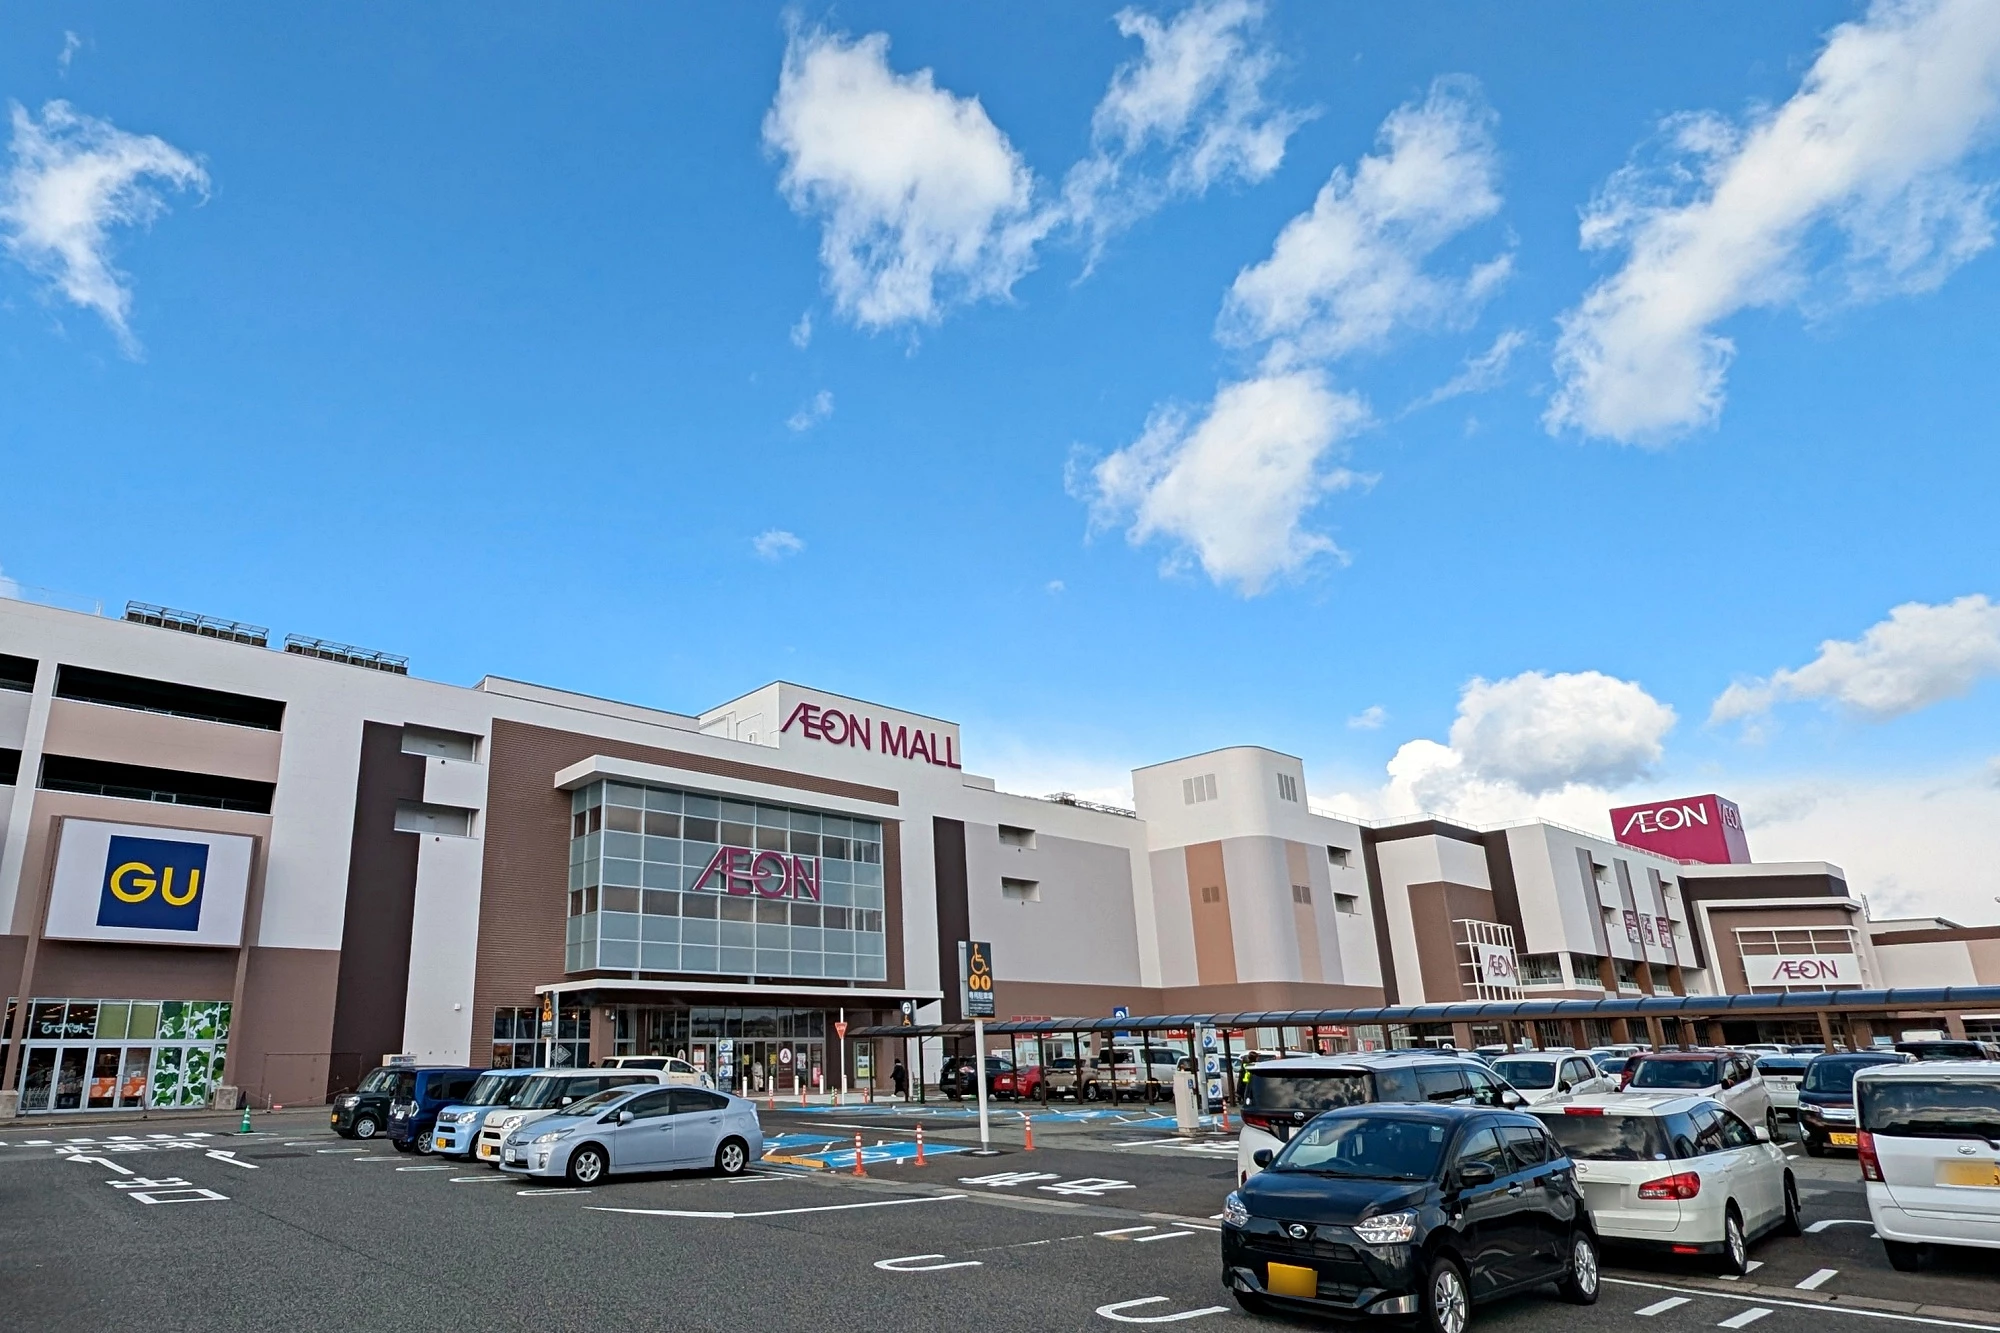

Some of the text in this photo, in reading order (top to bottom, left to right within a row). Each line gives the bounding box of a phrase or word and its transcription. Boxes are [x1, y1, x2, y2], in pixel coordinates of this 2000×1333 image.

[880, 720, 962, 769] MALL
[110, 861, 200, 906] GU
[105, 1177, 231, 1204] 出口
